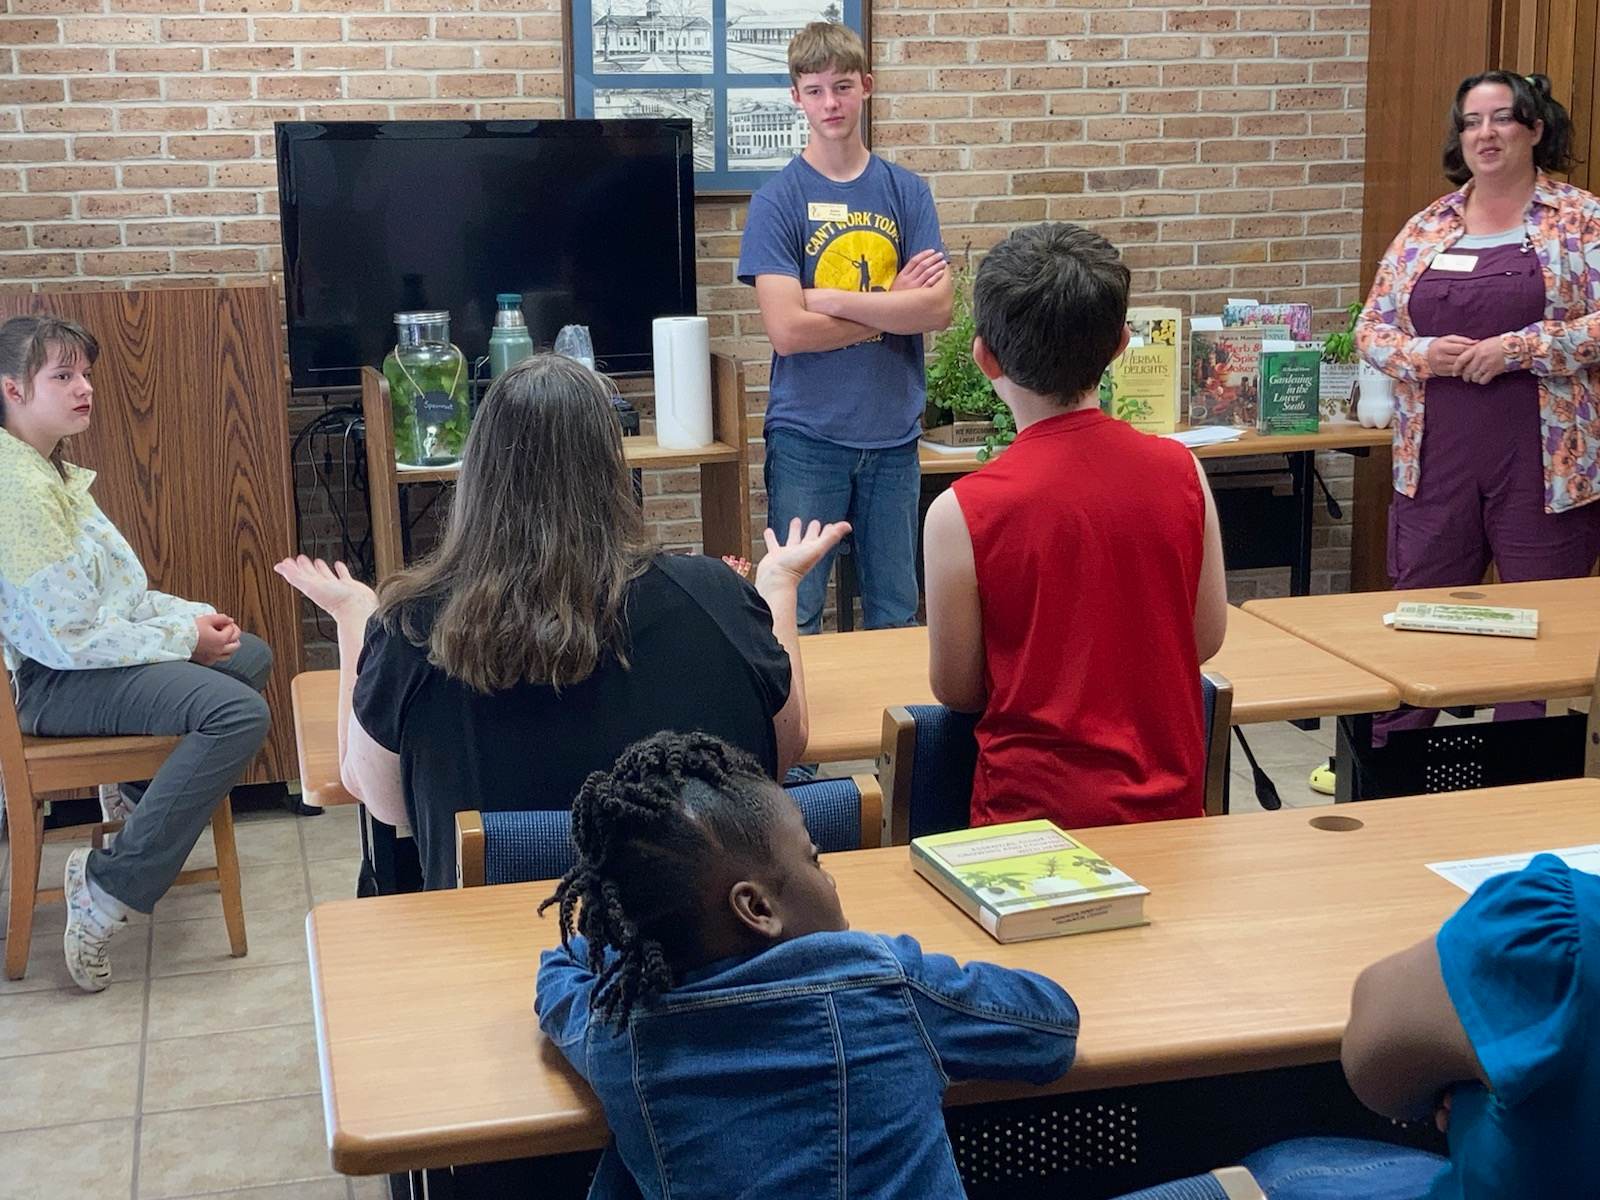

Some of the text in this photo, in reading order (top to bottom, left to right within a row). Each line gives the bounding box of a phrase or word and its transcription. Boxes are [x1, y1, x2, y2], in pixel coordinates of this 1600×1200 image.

[1114, 350, 1162, 368] HERBAL
[1232, 353, 1259, 363] Spic
[1123, 365, 1168, 375] DELIGHTS
[1269, 374, 1312, 387] Gardening
[1286, 384, 1308, 394] in the
[1273, 393, 1301, 402] Lower
[1282, 401, 1305, 411] South
